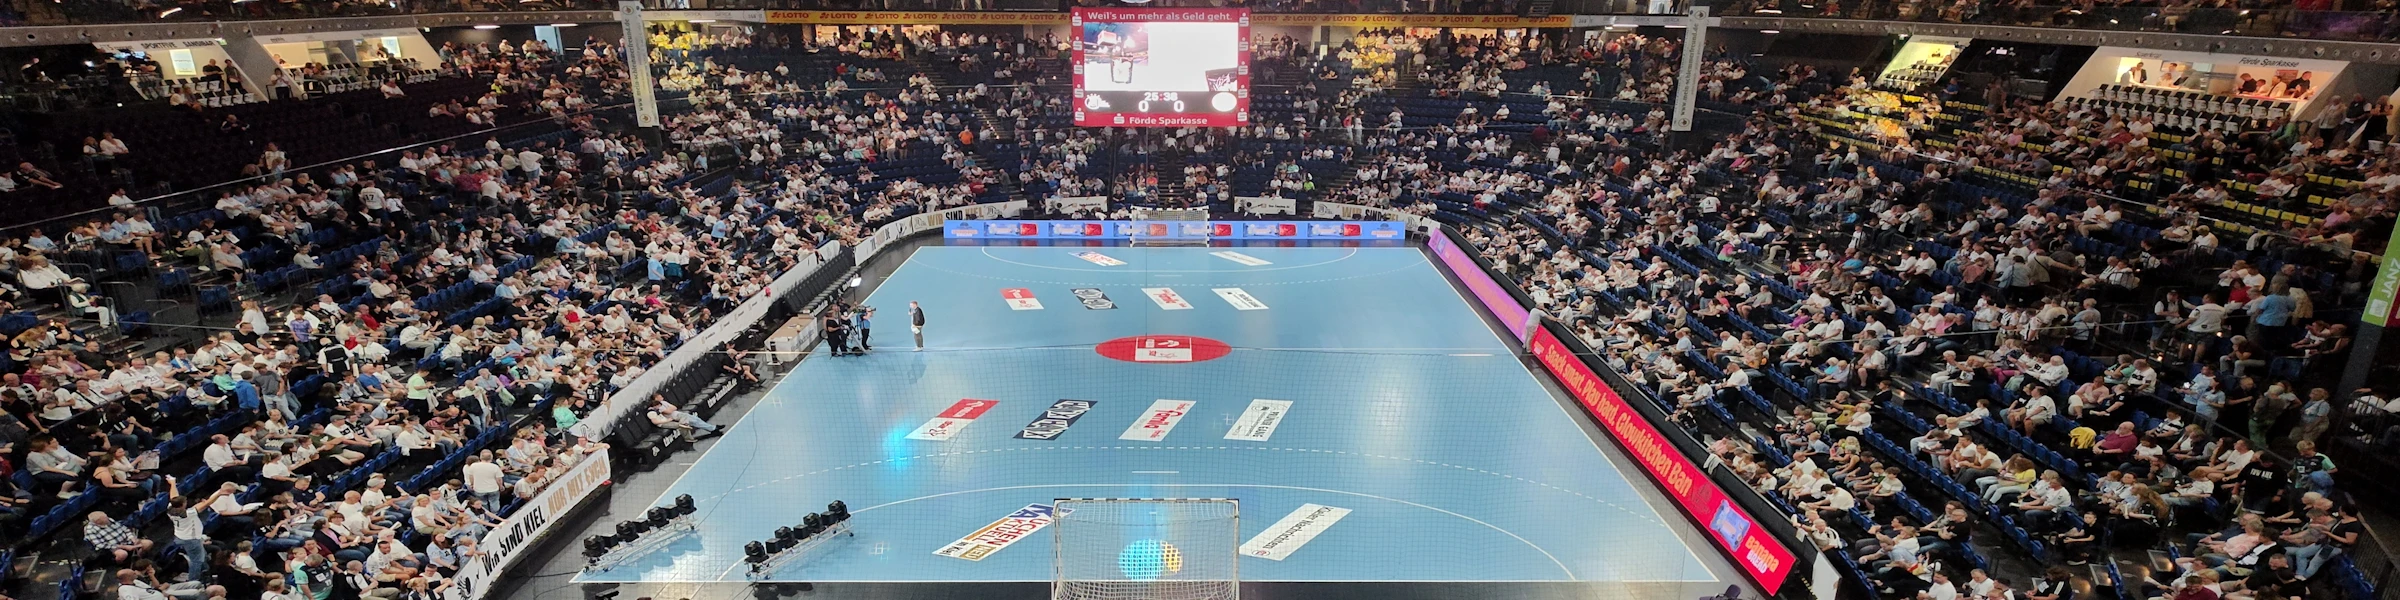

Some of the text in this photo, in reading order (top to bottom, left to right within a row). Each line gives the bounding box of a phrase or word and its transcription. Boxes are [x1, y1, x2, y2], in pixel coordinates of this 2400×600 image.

[1087, 12, 1117, 20] Weil's
[1137, 12, 1164, 20] mehr
[1166, 12, 1181, 20] als
[1182, 12, 1205, 20] Geld
[1207, 12, 1233, 21] geht.
[2239, 57, 2300, 68] Förde Sparkasse
[1144, 92, 1178, 101] 25:38
[1138, 100, 1149, 112] 0
[1173, 100, 1185, 112] 0
[1129, 116, 1208, 126] Förde Sparkasse
[945, 210, 963, 220] SIND
[1545, 344, 1567, 375] Snack
[1562, 363, 1585, 394] smart.
[1582, 379, 1599, 407] Play
[1596, 395, 1620, 426] hard.
[1615, 412, 1672, 478] Glowkitchen
[1667, 462, 1693, 497] Ban
[1262, 506, 1333, 549] Kieler Nachrichten
[499, 523, 524, 557] SIND
[1745, 535, 1780, 573] Banana
[1746, 550, 1768, 574] BREAD
